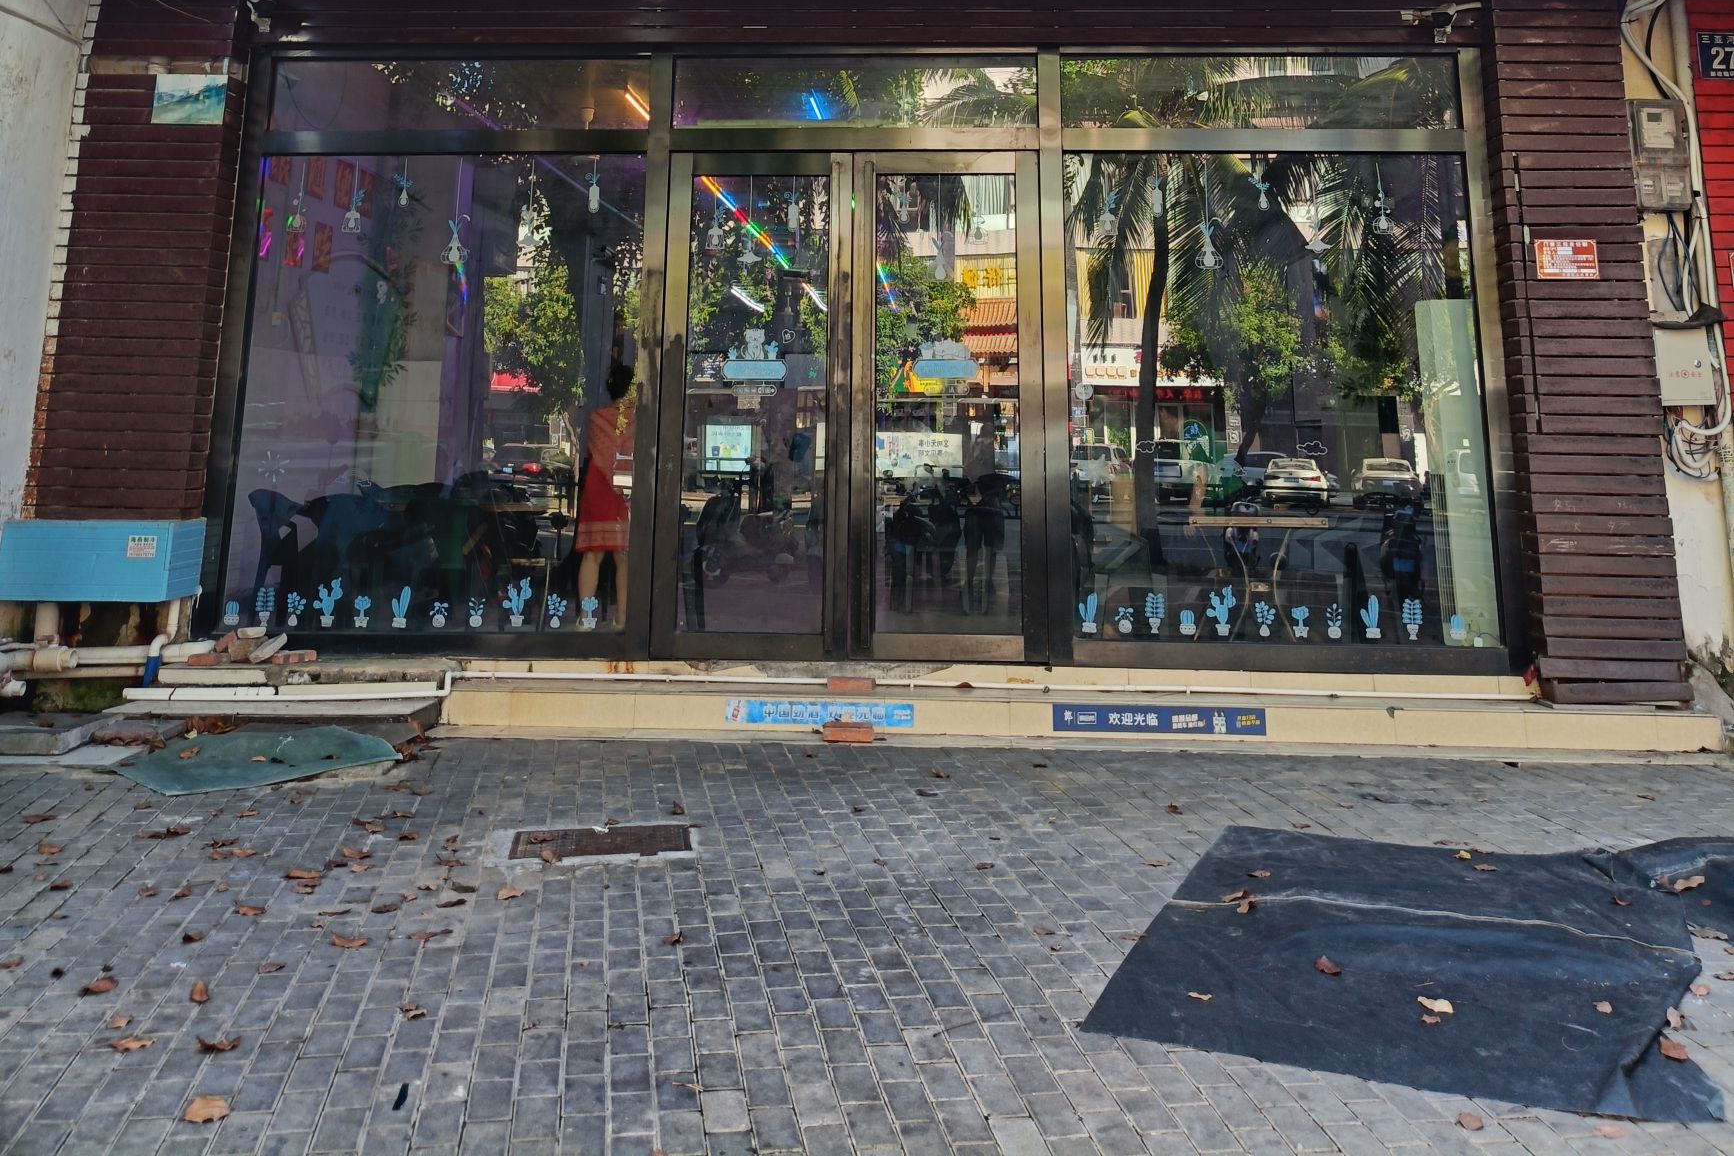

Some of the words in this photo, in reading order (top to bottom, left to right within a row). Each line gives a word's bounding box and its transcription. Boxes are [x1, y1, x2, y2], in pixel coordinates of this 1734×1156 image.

[763, 703, 821, 720] 中国劲酒
[1108, 712, 1159, 726] 欢迎光临
